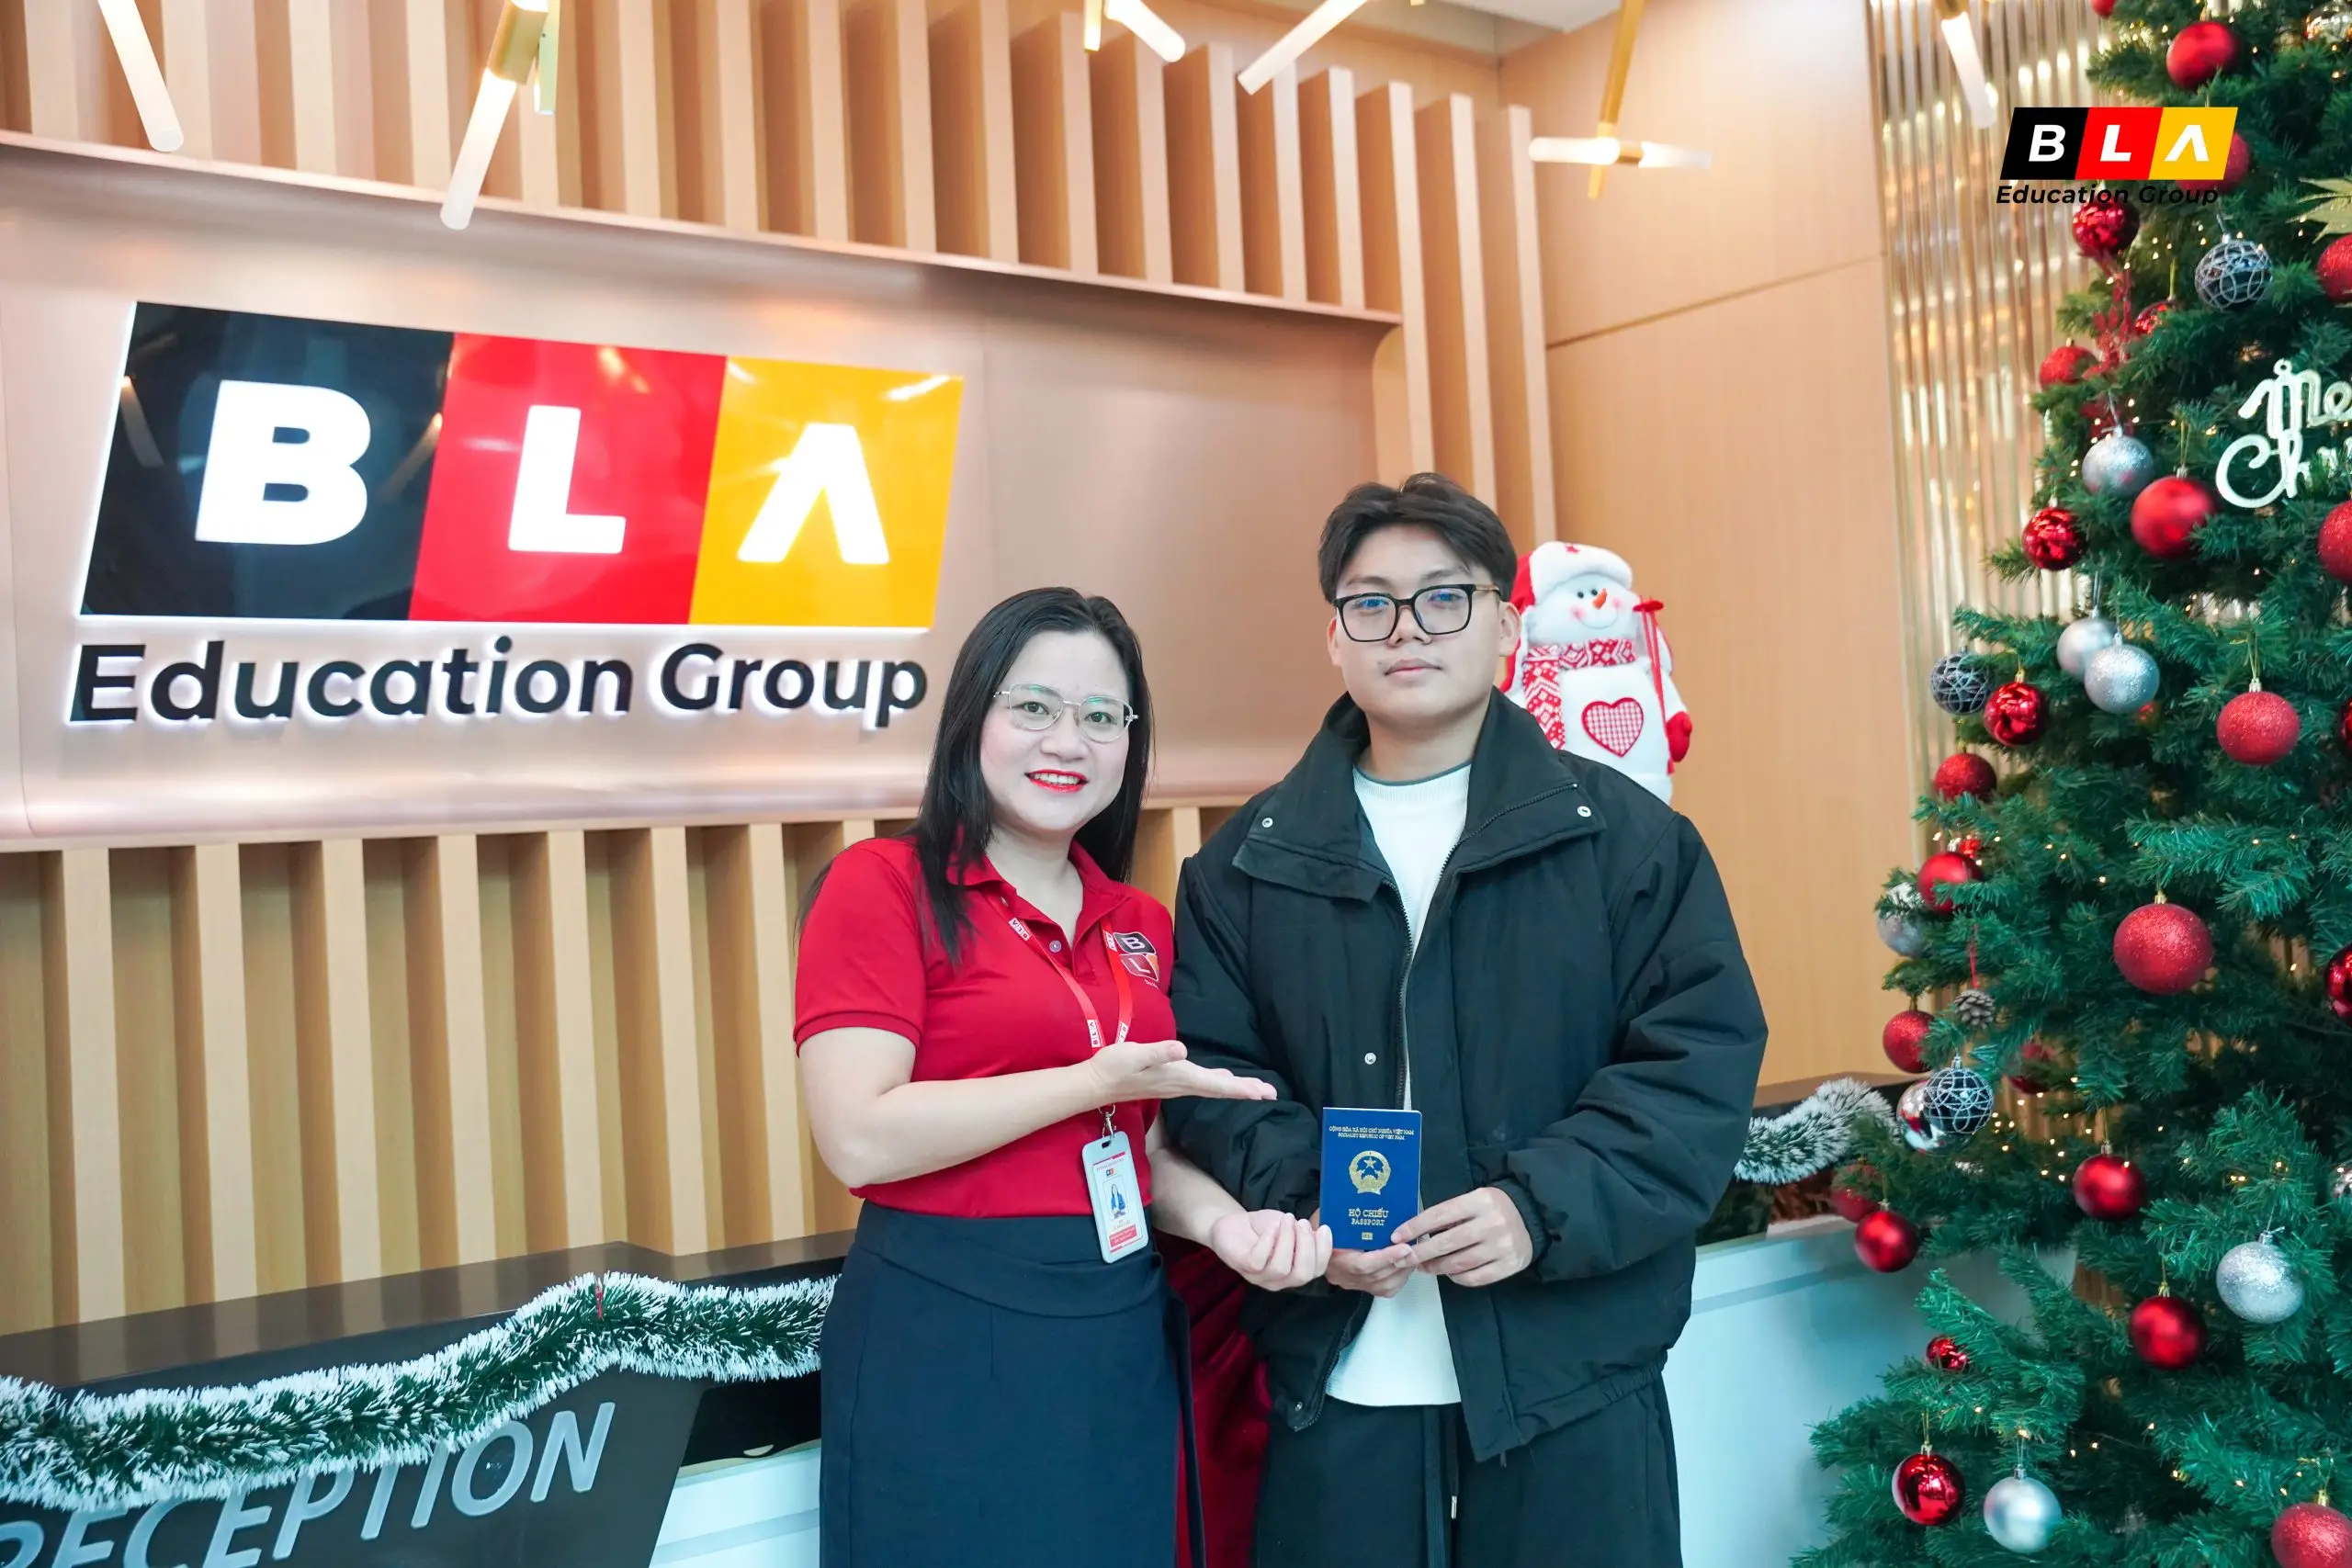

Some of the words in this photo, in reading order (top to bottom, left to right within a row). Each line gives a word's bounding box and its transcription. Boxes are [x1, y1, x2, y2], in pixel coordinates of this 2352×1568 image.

[2237, 358, 2352, 440] Me
[195, 378, 890, 564] BLA
[69, 636, 632, 724] Education
[658, 642, 929, 729] Group
[1351, 1218, 1385, 1226] PASSPORT
